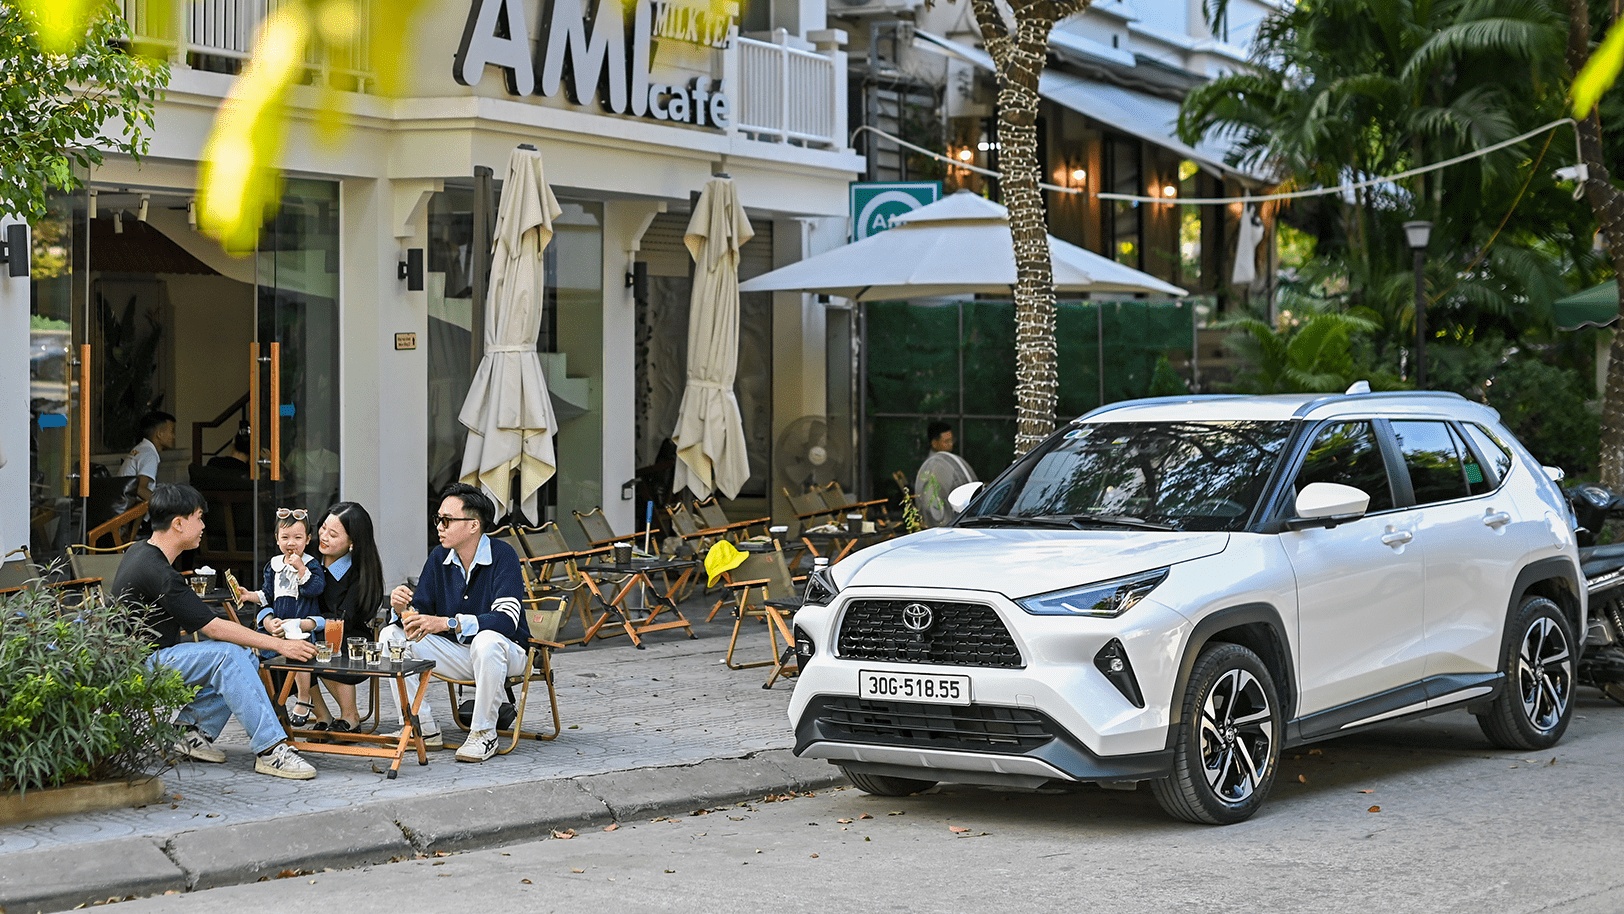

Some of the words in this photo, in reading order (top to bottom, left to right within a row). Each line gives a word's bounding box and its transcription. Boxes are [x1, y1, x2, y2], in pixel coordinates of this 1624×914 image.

[653, 1, 698, 42] MILK
[458, 0, 652, 117] AMI
[868, 676, 961, 699] 30G-518.55
